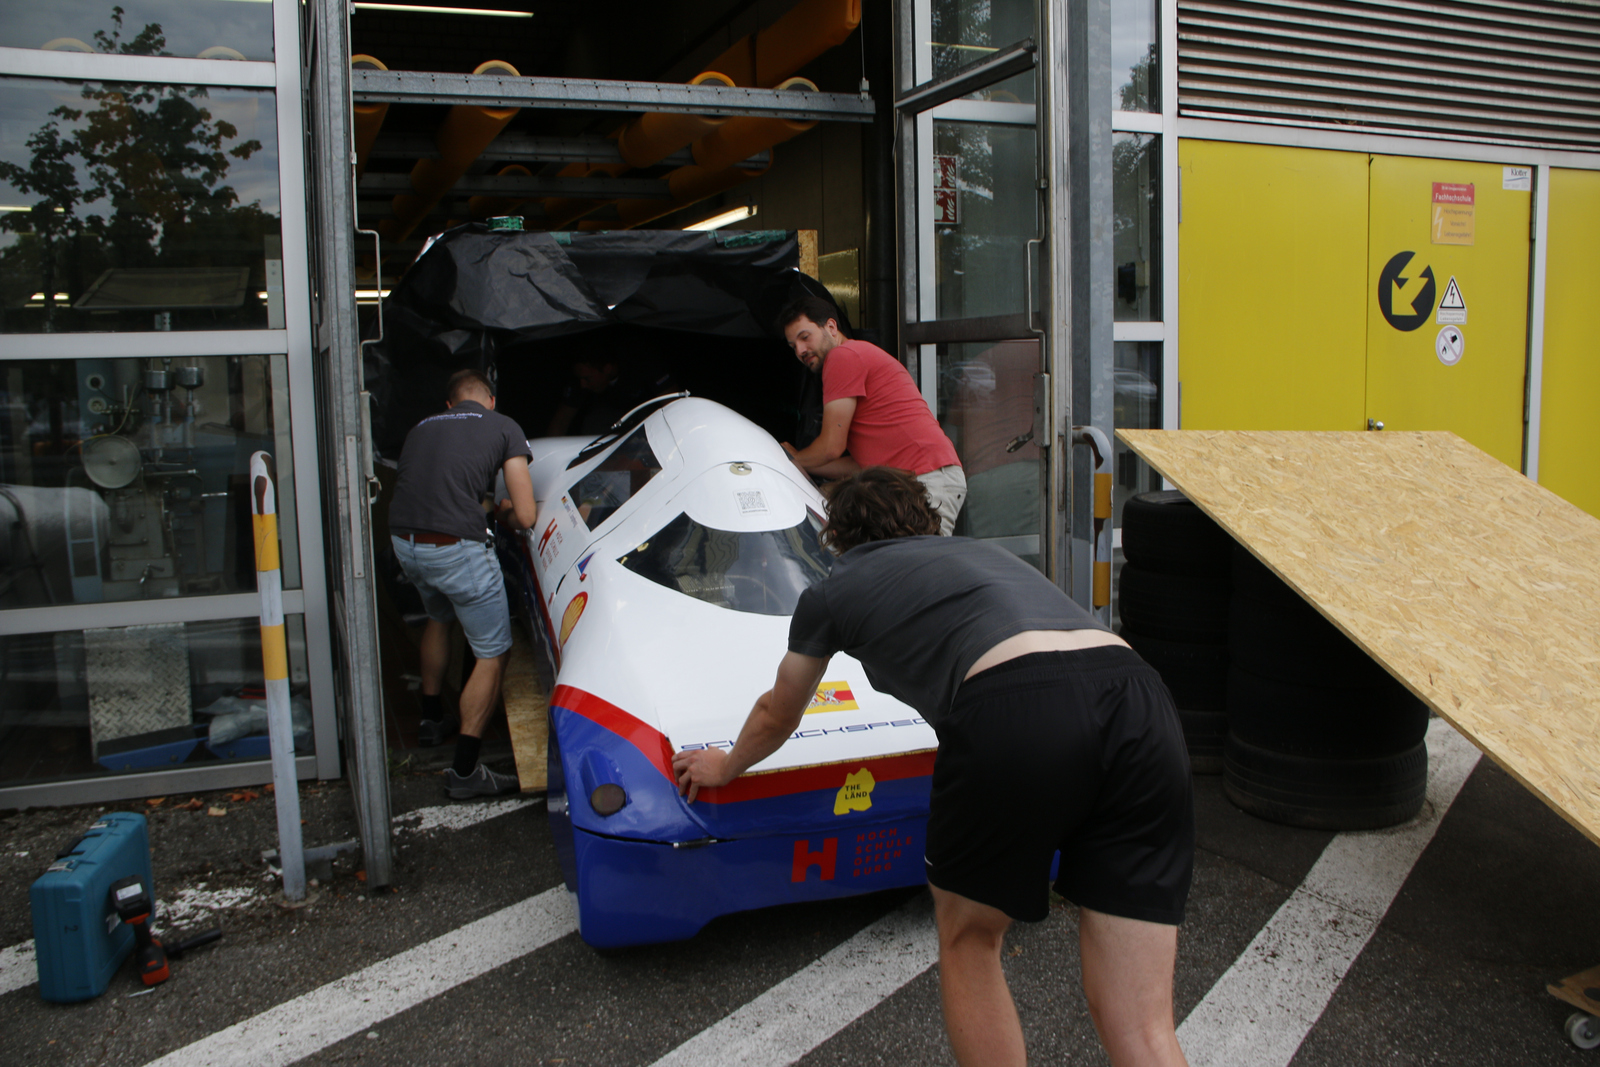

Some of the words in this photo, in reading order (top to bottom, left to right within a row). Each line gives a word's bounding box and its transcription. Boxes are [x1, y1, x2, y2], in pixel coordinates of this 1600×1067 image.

[1435, 193, 1472, 202] Fachhochschule
[845, 784, 861, 792] THE
[845, 791, 868, 800] LÄND
[856, 827, 898, 843] HOCH
[855, 836, 913, 855] SCHULE
[853, 849, 902, 866] OFFEN
[853, 862, 892, 878] BURG
